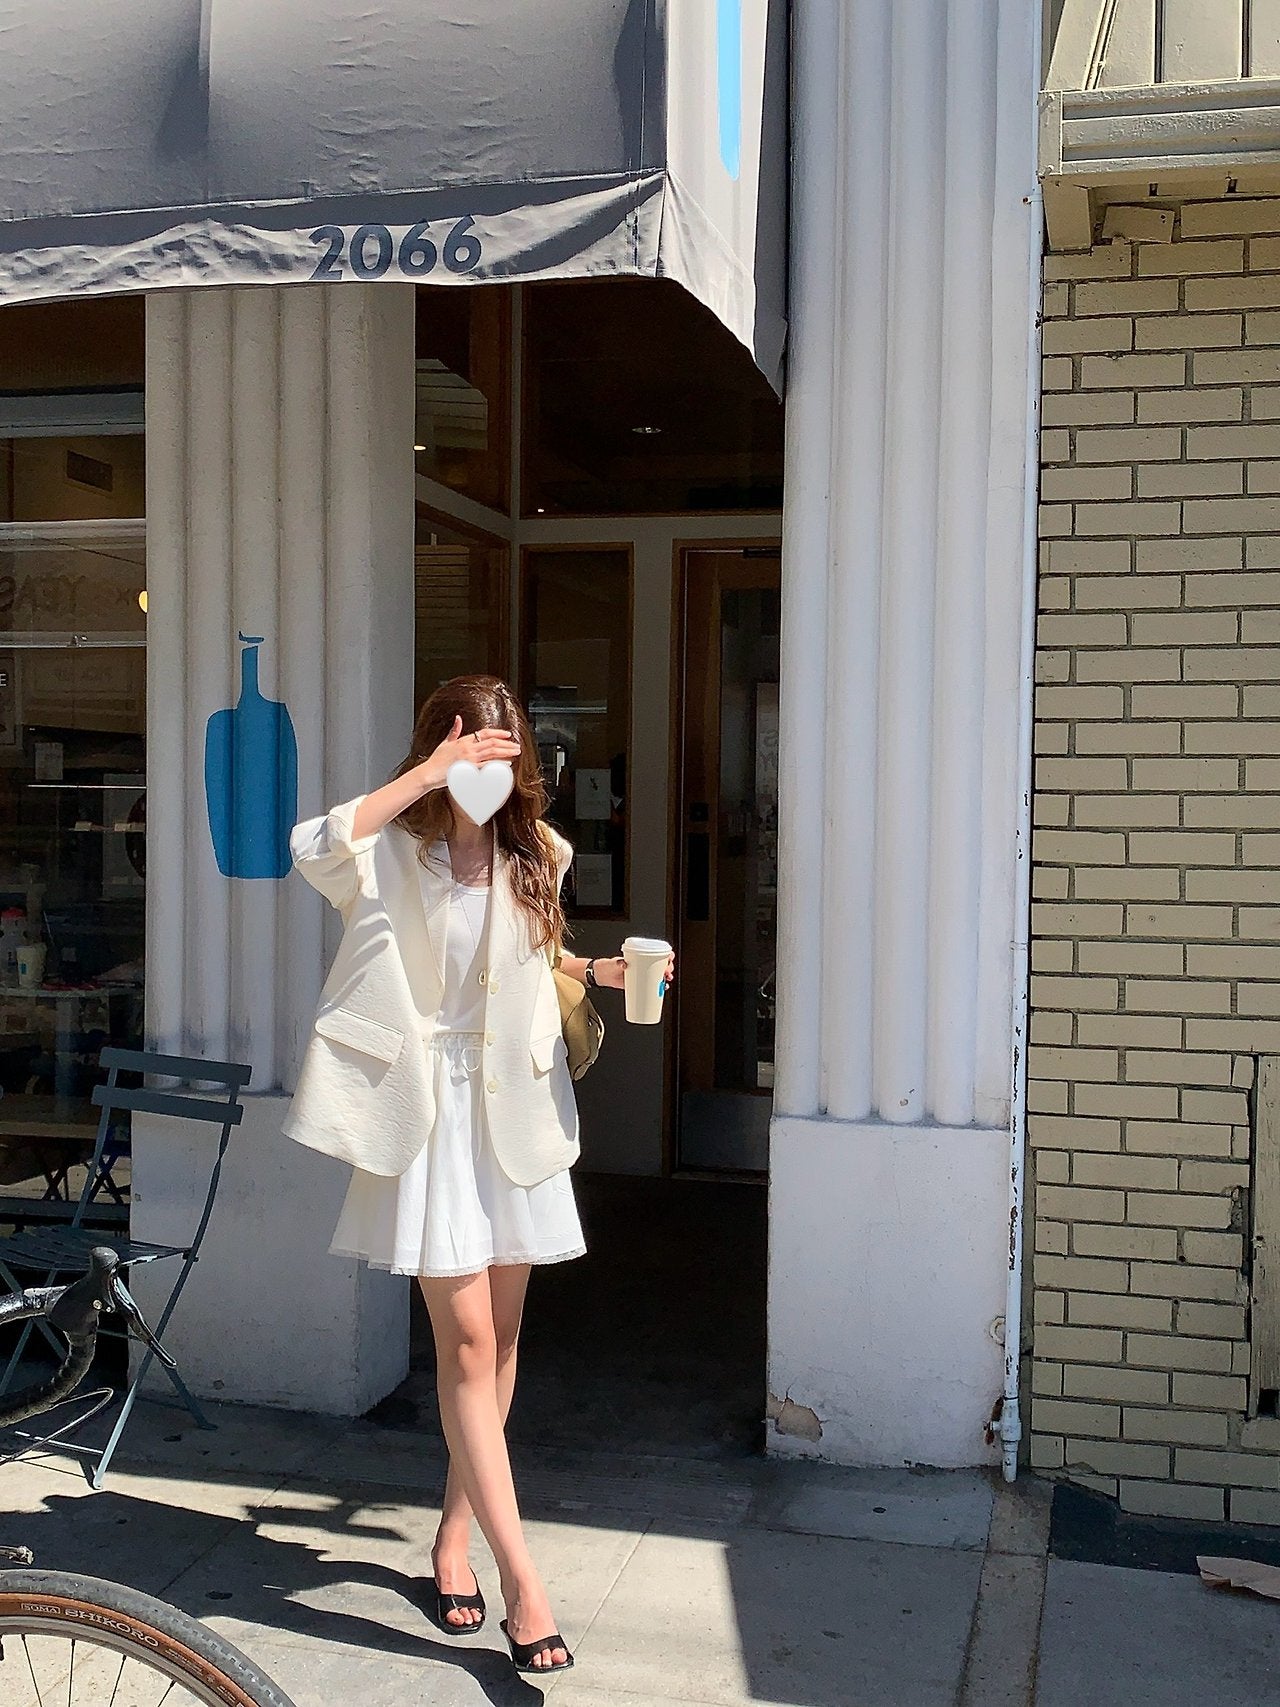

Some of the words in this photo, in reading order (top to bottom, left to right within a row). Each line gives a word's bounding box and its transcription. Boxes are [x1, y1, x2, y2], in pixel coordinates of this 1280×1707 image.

[308, 214, 482, 281] 2066
[22, 1603, 60, 1614] SOMA
[65, 1608, 159, 1647] SHIKORO
